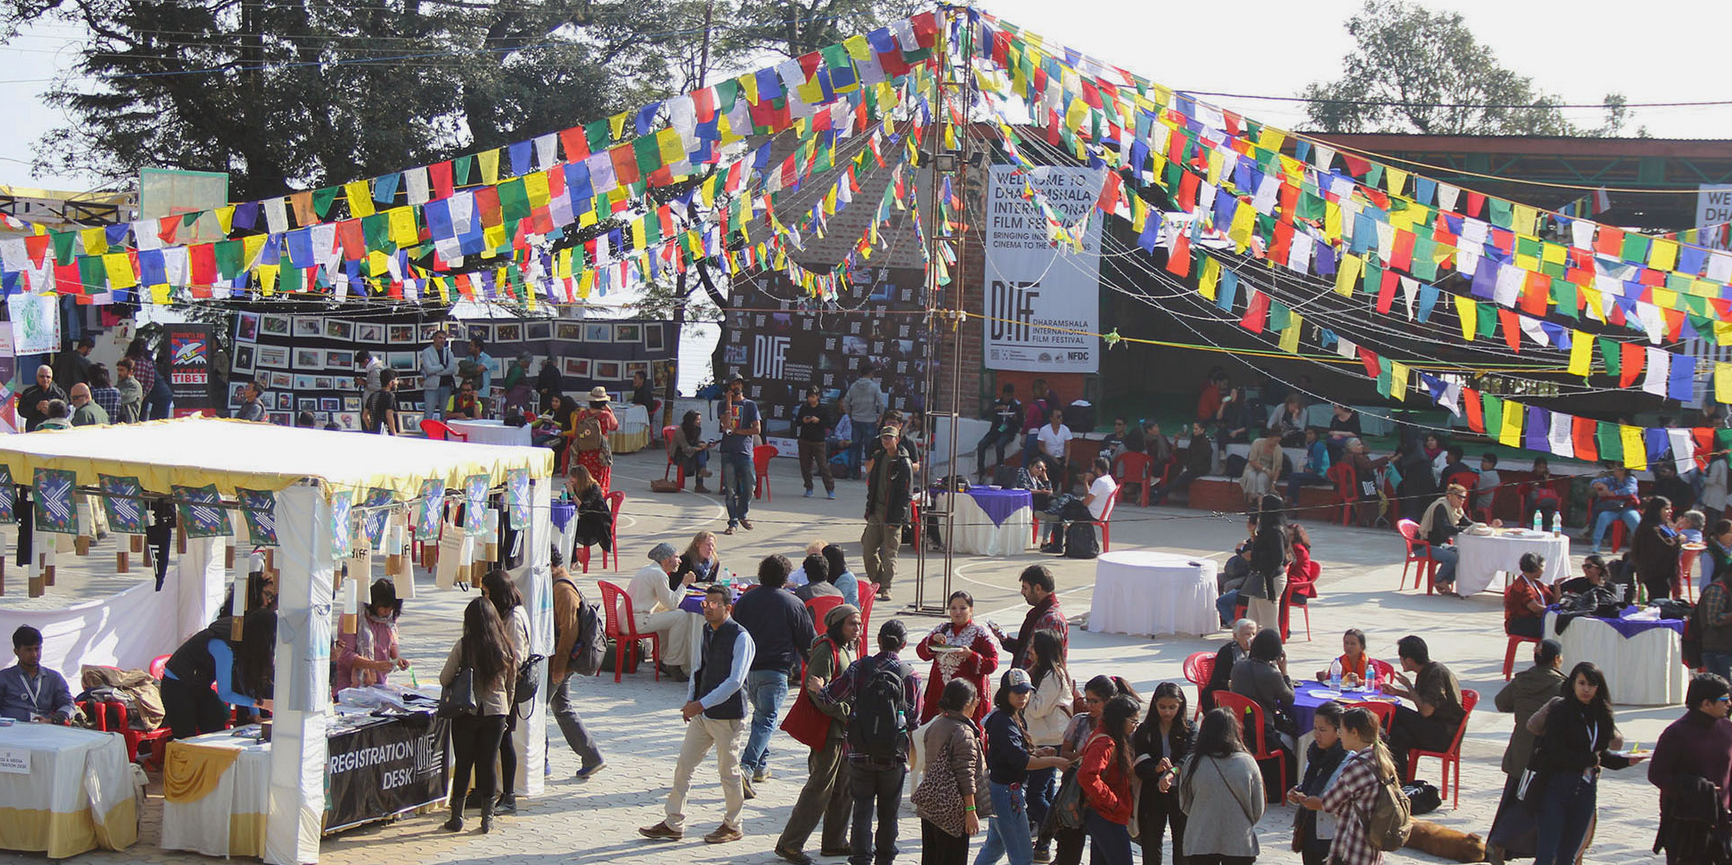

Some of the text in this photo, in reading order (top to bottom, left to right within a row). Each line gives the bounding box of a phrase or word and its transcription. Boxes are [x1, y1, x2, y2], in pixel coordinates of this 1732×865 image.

[997, 172, 1065, 187] WELOME
[995, 187, 1092, 201] DHAMSHALA
[993, 217, 1023, 228] FILM
[993, 231, 1030, 240] BRINGING
[993, 241, 1022, 249] CINEMA
[1024, 242, 1034, 250] TO
[1036, 242, 1048, 250] THE
[1032, 319, 1089, 328] DHARAMSHALA
[1032, 328, 1089, 336] INTERNATIONAL
[1032, 335, 1085, 344] FILM FESTIVAL
[1067, 351, 1089, 361] NFDC
[172, 374, 207, 383] TIBET
[330, 740, 414, 775] REGISTRATION
[382, 766, 414, 790] DESK
